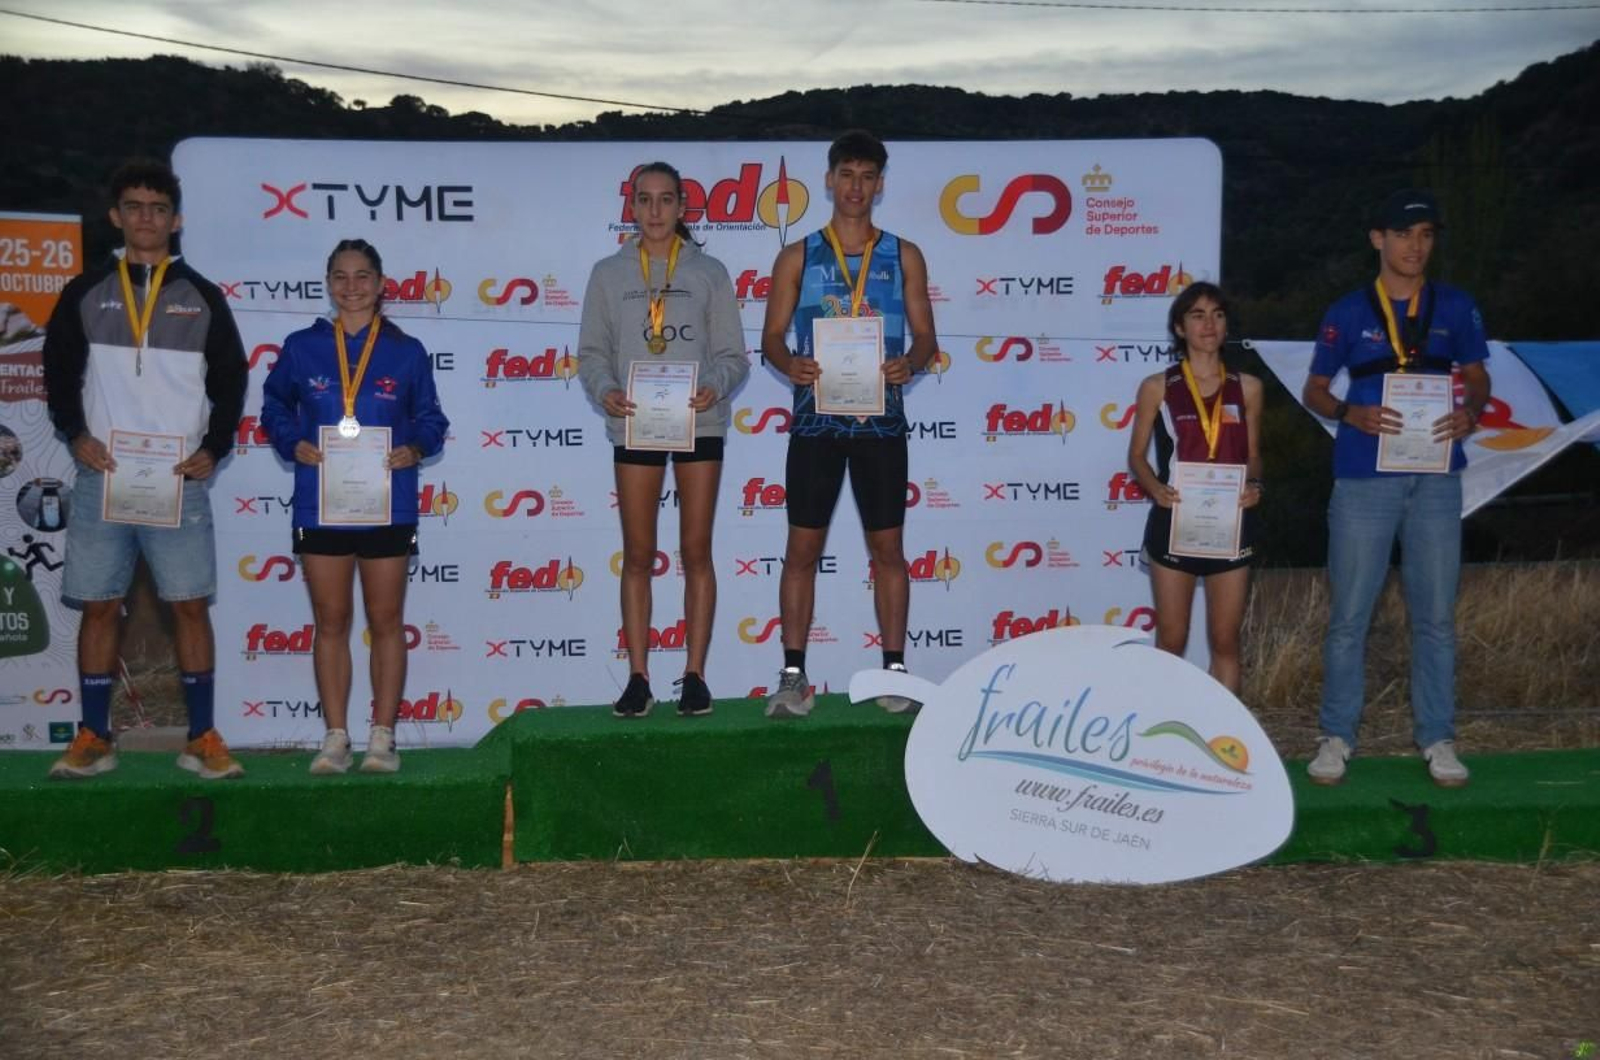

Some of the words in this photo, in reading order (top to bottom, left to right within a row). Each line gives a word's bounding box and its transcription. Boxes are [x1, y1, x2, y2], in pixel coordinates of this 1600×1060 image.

[260, 182, 474, 222] XTYME
[1085, 196, 1135, 212] Consejo
[1085, 211, 1138, 225] Superior
[1085, 224, 1101, 235] de
[1104, 224, 1160, 237] Deportes
[0, 238, 74, 269] 25-26
[219, 280, 323, 299] XTYME
[976, 276, 1073, 295] XTYME
[0, 363, 44, 377] ENTAC
[1, 379, 48, 395] Fraile
[481, 428, 583, 447] XTYME
[983, 482, 1080, 501] XTYME
[234, 496, 293, 515] XTY
[4, 586, 15, 605] Y
[0, 612, 29, 631] TOS
[246, 623, 315, 652] fed
[863, 630, 963, 649] XYME
[486, 638, 586, 658] XTYME
[243, 700, 326, 718] XTYM
[957, 663, 1138, 762] frailes
[1014, 778, 1165, 824] www.frailes.es
[175, 796, 222, 853] 2
[1009, 808, 1056, 831] SIERRA
[1059, 819, 1088, 836] SUR
[1090, 826, 1110, 842] DE
[1388, 798, 1436, 858] 3
